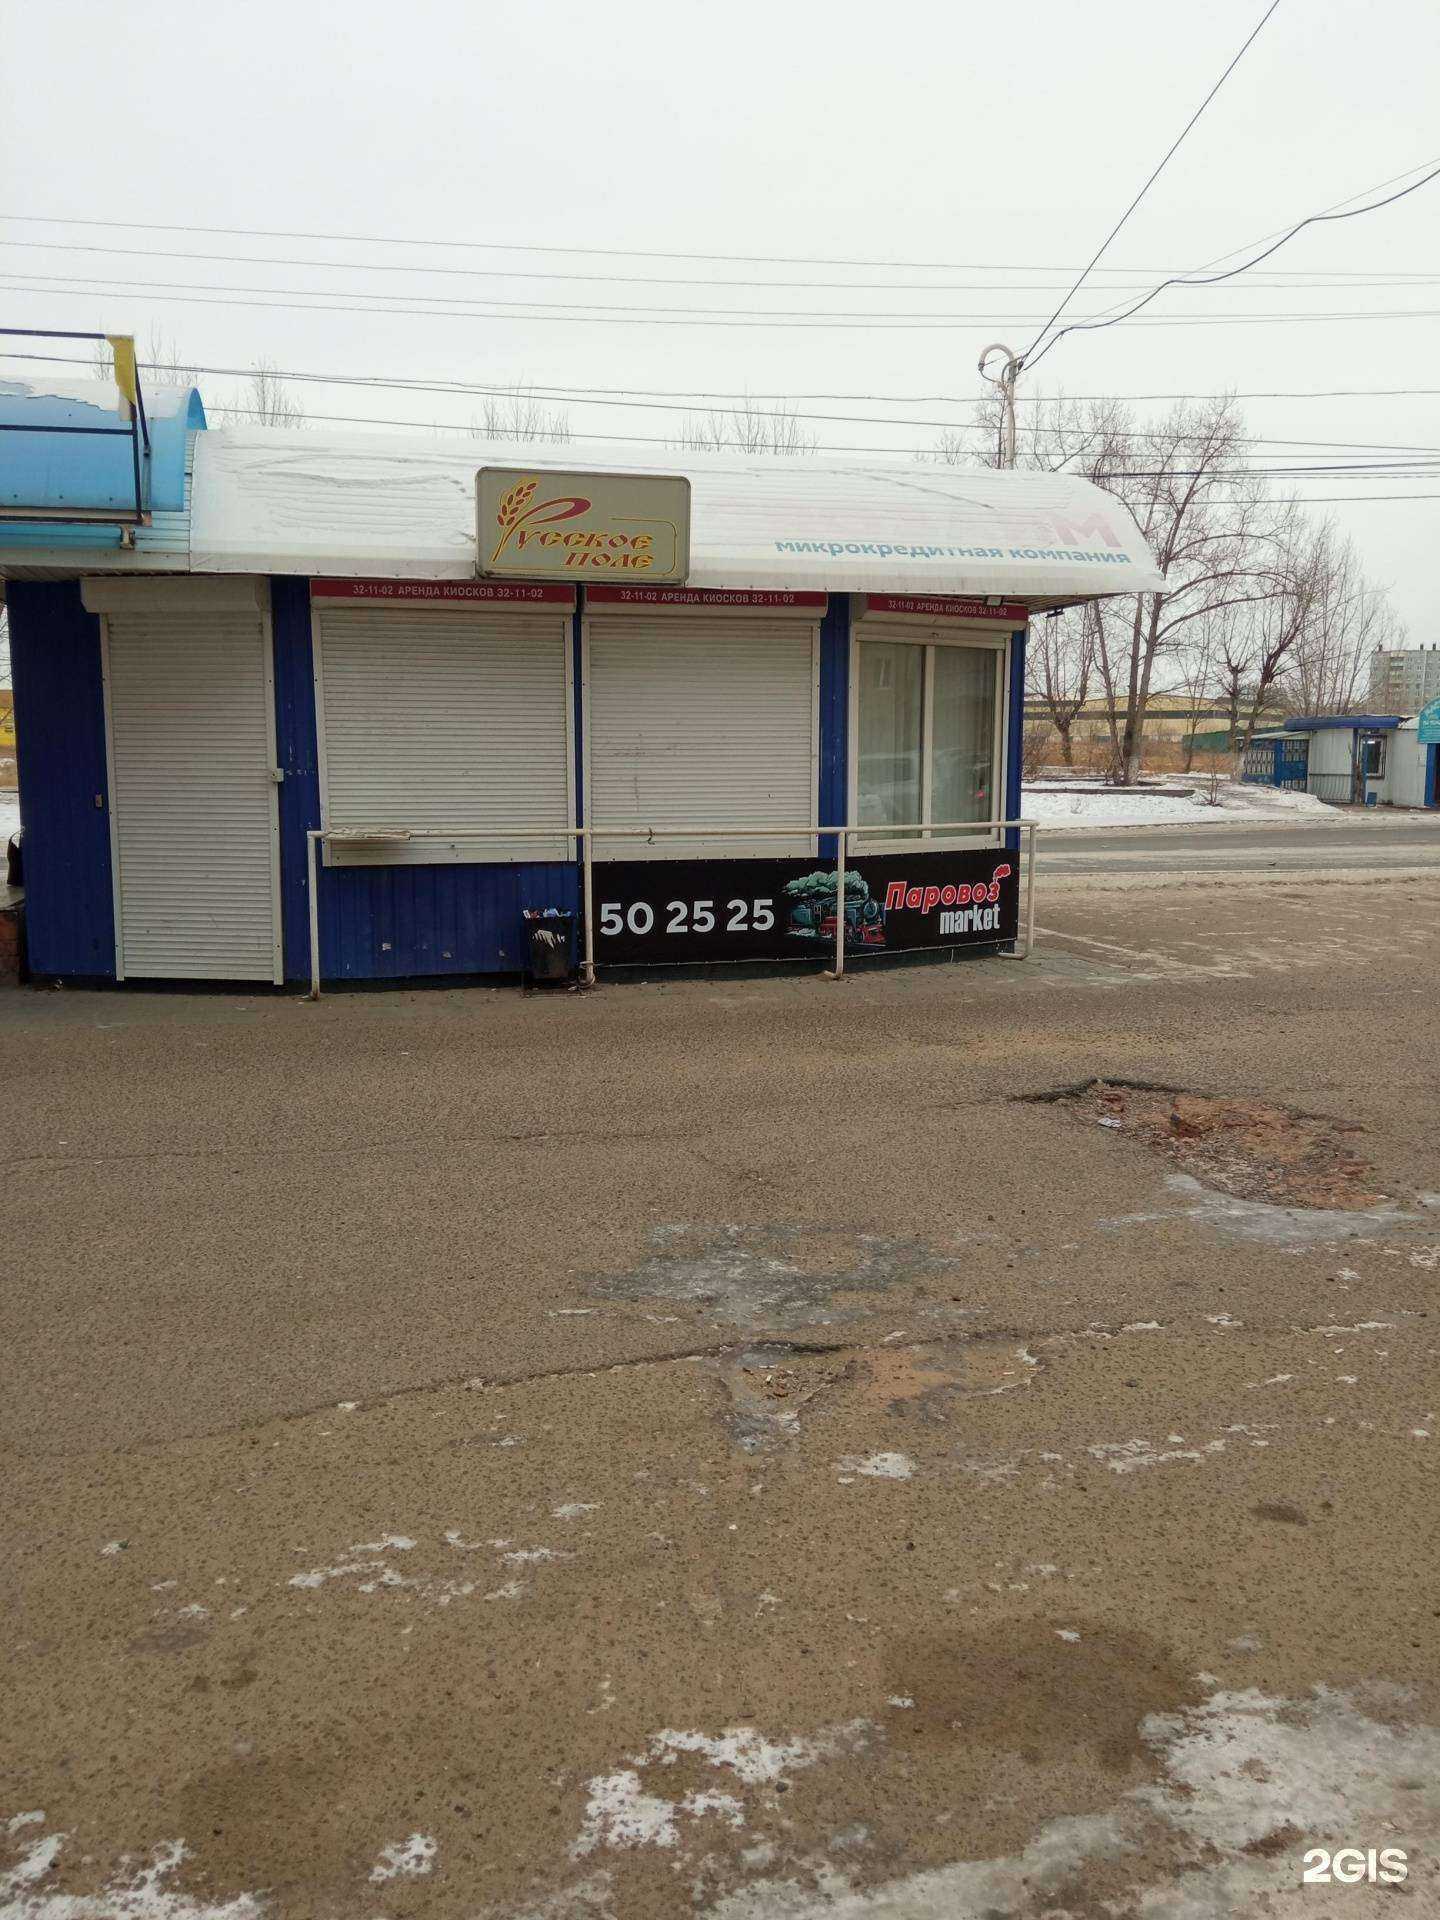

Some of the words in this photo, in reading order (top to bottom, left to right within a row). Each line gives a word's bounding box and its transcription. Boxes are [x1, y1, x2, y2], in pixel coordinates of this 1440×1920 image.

[775, 540, 1004, 559] микрокредитная
[1010, 549, 1132, 564] компания
[353, 584, 393, 595] 32-11-02
[398, 585, 440, 597] АРЕНДА
[443, 586, 494, 598] КИОСКОВ
[496, 588, 543, 598] 32-11-02
[620, 590, 657, 601] 32-11-02
[661, 592, 701, 604] АРЕНДА
[703, 593, 749, 604] КИОСКОВ
[752, 593, 795, 604] 32-11-02
[916, 602, 944, 613] АРЕНДА
[945, 604, 977, 615] КИОСКОВ
[884, 880, 1001, 915] Паровоз
[600, 902, 654, 936] 50
[666, 900, 716, 933] 25
[726, 899, 775, 931] 25
[939, 903, 1001, 935] market
